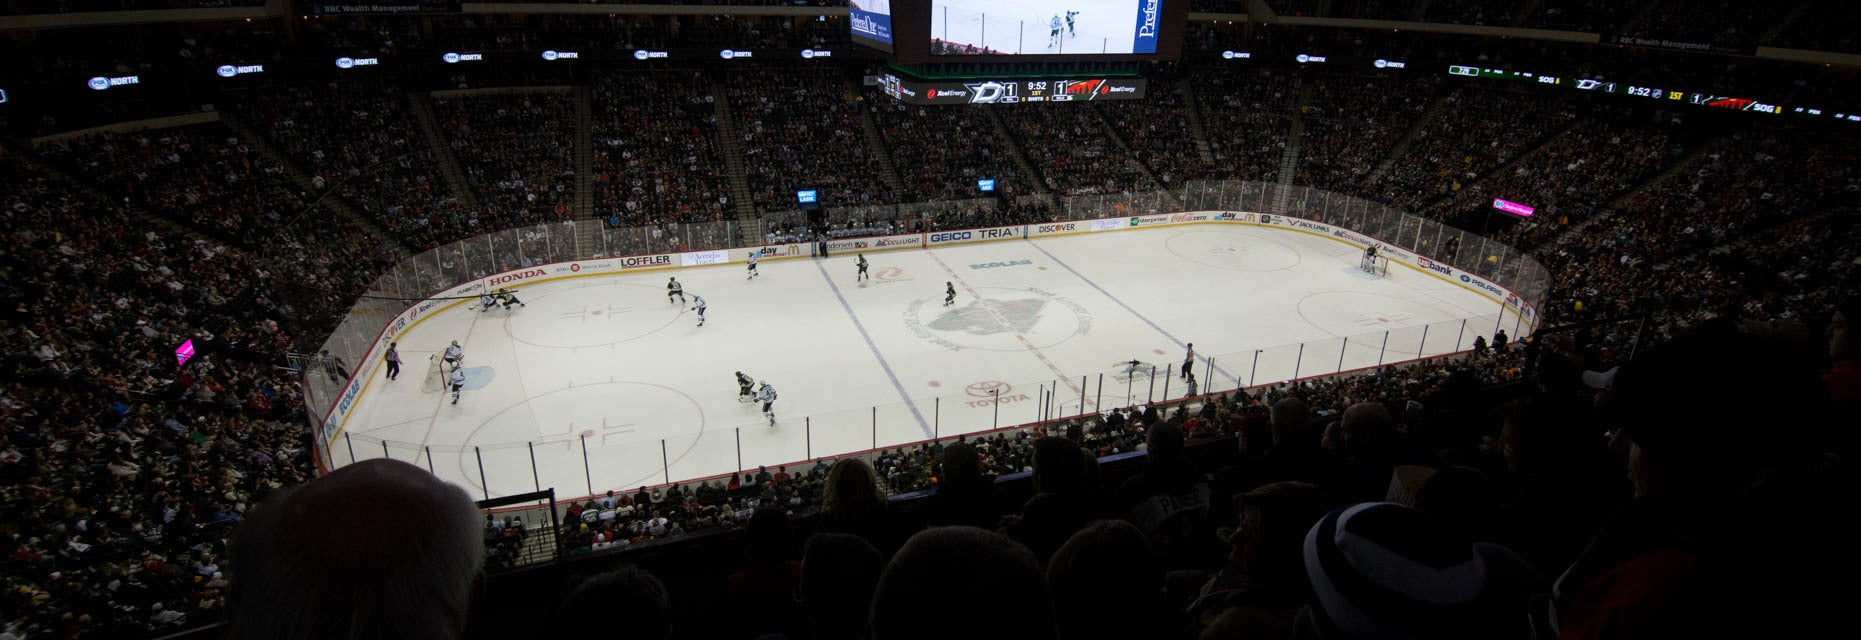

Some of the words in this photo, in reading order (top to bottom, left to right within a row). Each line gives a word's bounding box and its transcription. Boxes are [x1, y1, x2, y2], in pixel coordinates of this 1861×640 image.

[355, 58, 378, 66] NORTH
[238, 65, 264, 73] NORTH
[110, 76, 139, 86] NORTH
[1538, 76, 1555, 84] SOG
[1007, 84, 1013, 96] 1
[1028, 81, 1047, 90] 9:52
[1057, 82, 1063, 95] 1
[1627, 86, 1650, 97] 9:52
[1668, 91, 1683, 101] 1ST
[1753, 104, 1774, 113] SOG
[979, 228, 1012, 239] TRIA
[1039, 224, 1075, 233] DISCOVER
[902, 237, 920, 245] LIGHT
[931, 231, 971, 243] GEICO
[761, 246, 777, 254] day
[826, 241, 853, 249] ndersen
[620, 255, 670, 267] LOFFLER
[969, 259, 1033, 270] ECOLAB
[489, 268, 547, 286] HONDA
[1472, 279, 1503, 296] POLARIS
[339, 379, 360, 415] ECOLAB
[965, 393, 1031, 409] TOYOTA
